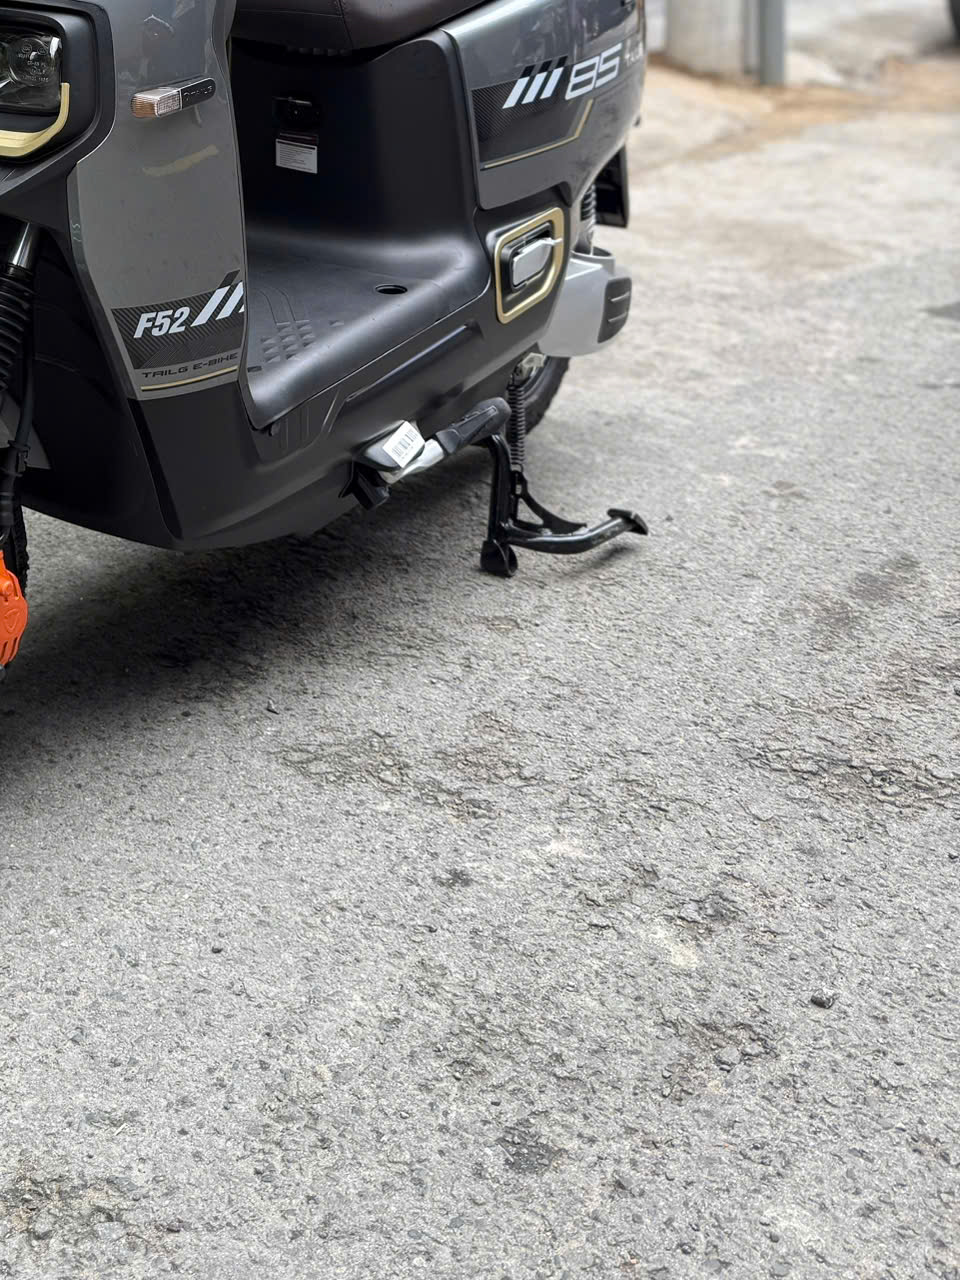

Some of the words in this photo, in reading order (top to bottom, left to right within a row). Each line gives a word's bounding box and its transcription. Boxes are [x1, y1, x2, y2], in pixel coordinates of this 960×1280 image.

[565, 43, 622, 100] 85
[133, 306, 190, 338] F52
[141, 365, 188, 378] TAILG
